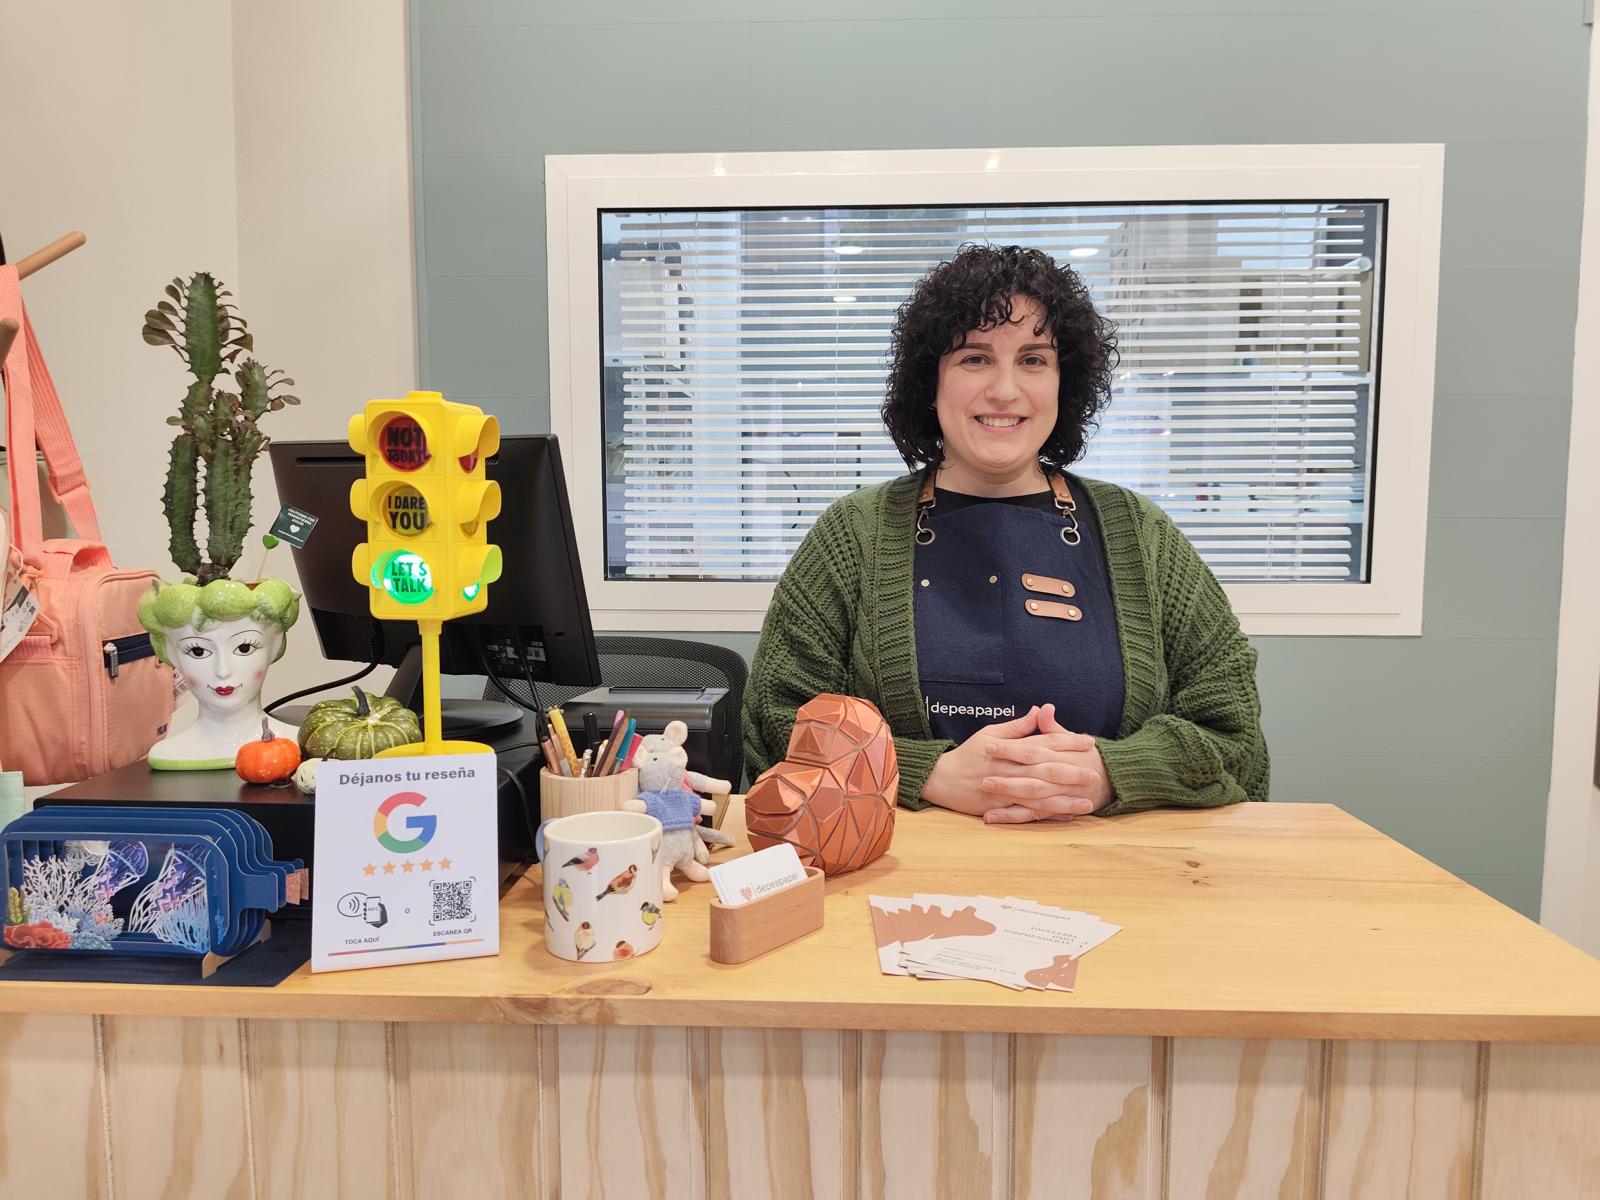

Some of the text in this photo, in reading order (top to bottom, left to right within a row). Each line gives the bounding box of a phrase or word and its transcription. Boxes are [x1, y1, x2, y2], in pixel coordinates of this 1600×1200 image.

[387, 426, 423, 448] NOT
[388, 496, 426, 510] I DARE
[389, 511, 426, 530] YOU
[391, 561, 427, 577] LETS
[393, 577, 428, 593] TALK
[930, 701, 1015, 719] depeapapel
[339, 767, 476, 786] Déjanos tu reseña
[433, 929, 462, 937] ESCANEA
